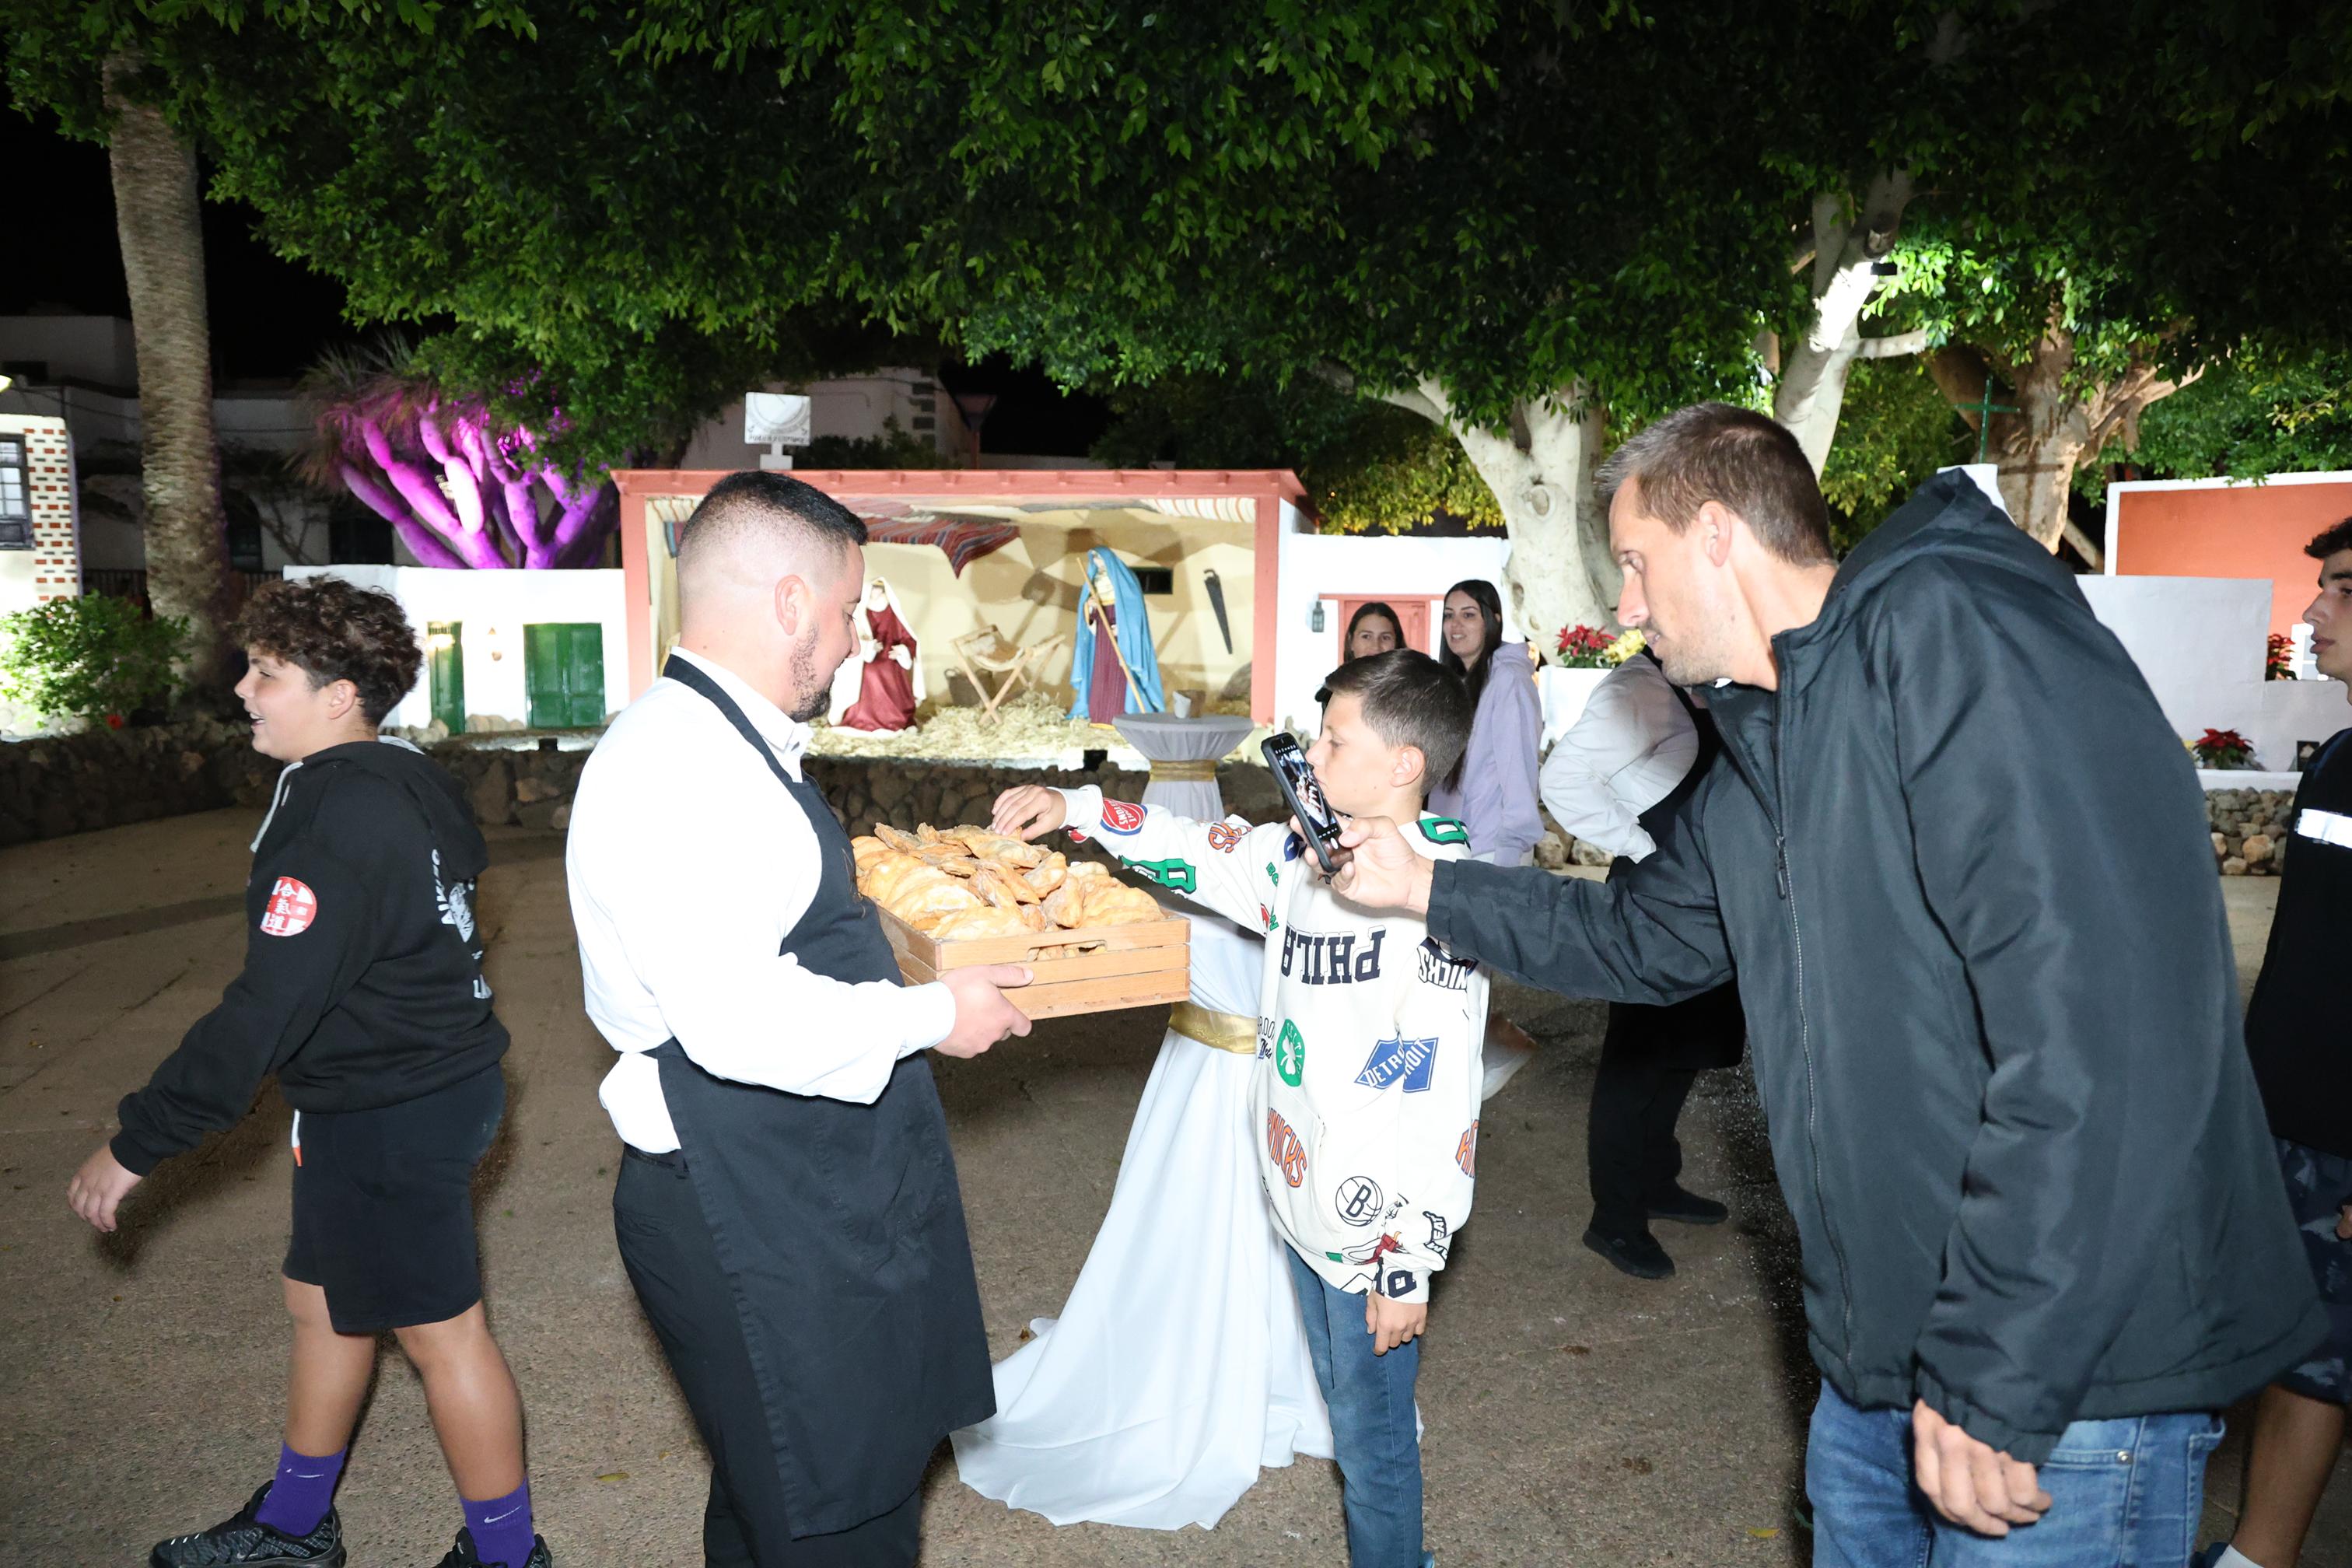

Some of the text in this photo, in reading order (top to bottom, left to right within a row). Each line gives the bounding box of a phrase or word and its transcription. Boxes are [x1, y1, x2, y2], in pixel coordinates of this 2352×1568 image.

[1281, 923, 1386, 985] PHILA
[1417, 945, 1468, 990] NICKS
[1268, 1107, 1307, 1188] NICKS
[1346, 1184, 1371, 1218] B
